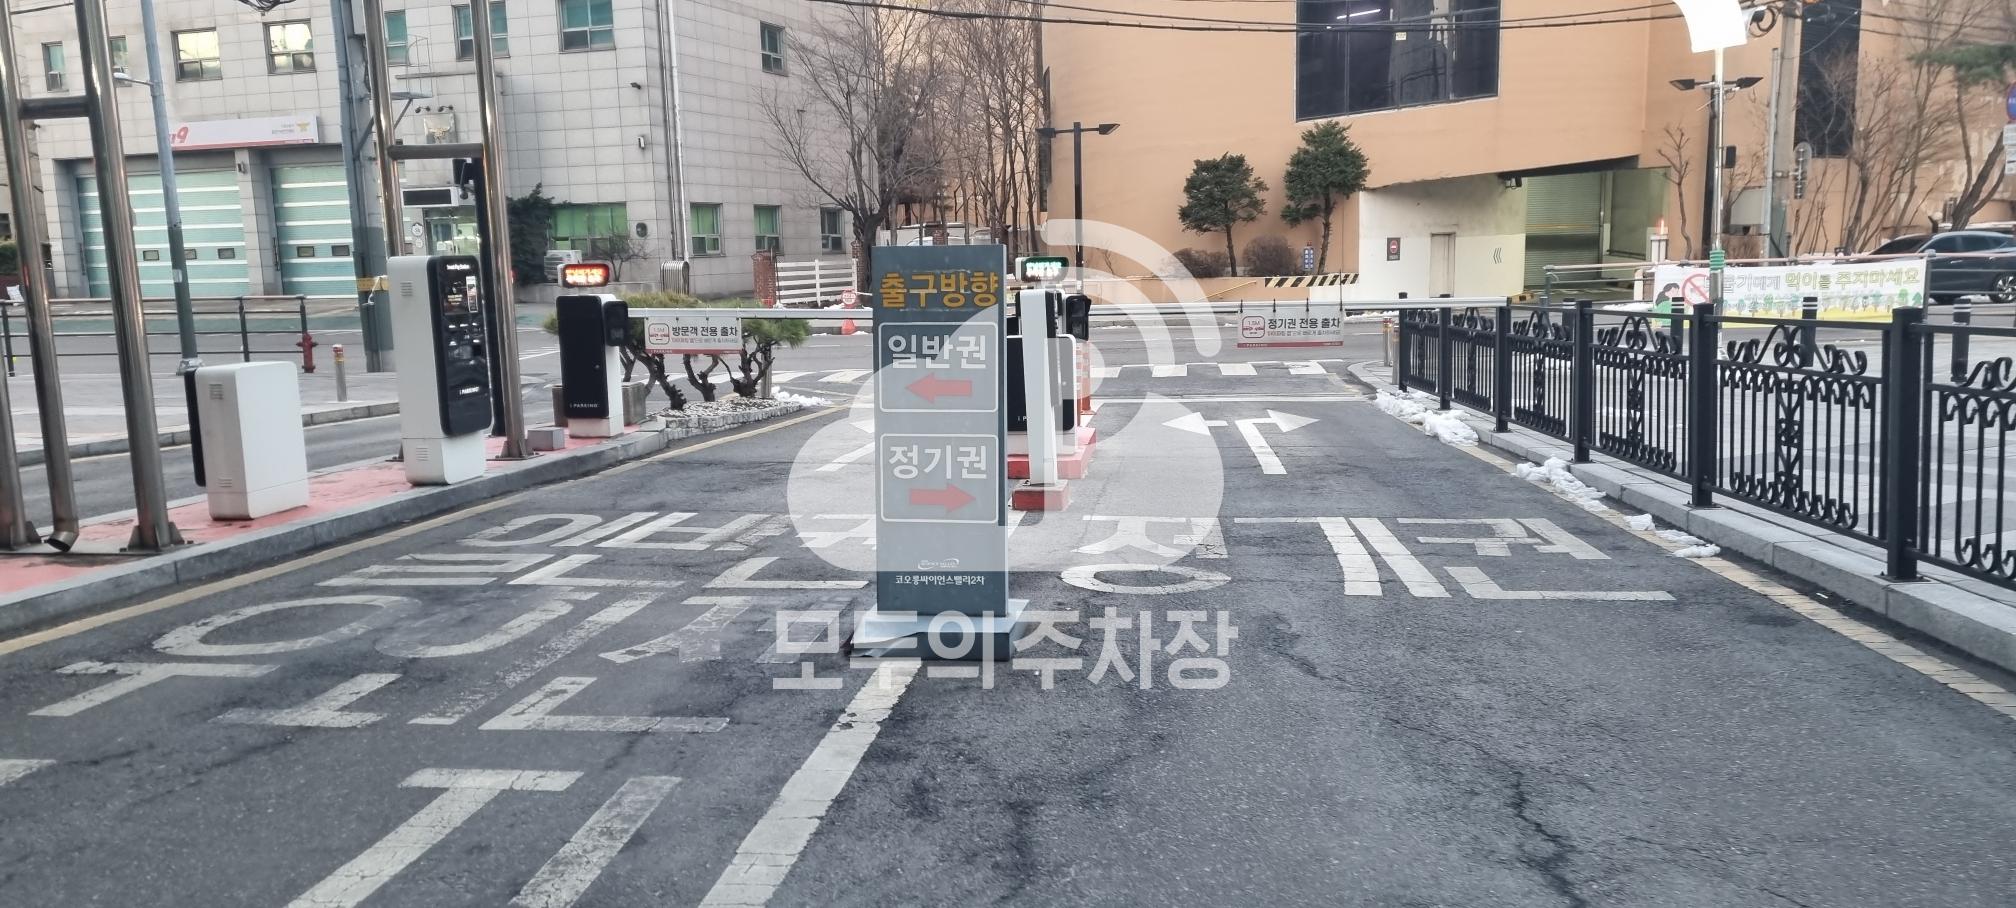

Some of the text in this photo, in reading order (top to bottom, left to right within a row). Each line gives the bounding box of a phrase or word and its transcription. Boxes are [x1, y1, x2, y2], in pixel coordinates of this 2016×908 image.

[879, 271, 998, 309] 출구방향
[671, 326, 698, 337] 방문객
[700, 326, 718, 337] 전용
[720, 326, 738, 337] 출차
[1267, 318, 1297, 330] 정기권
[1299, 317, 1318, 329] 전용
[1321, 317, 1341, 329] 출차
[887, 333, 988, 370] 일반권
[887, 443, 989, 480] 정기권
[1061, 514, 1677, 602] 정기권
